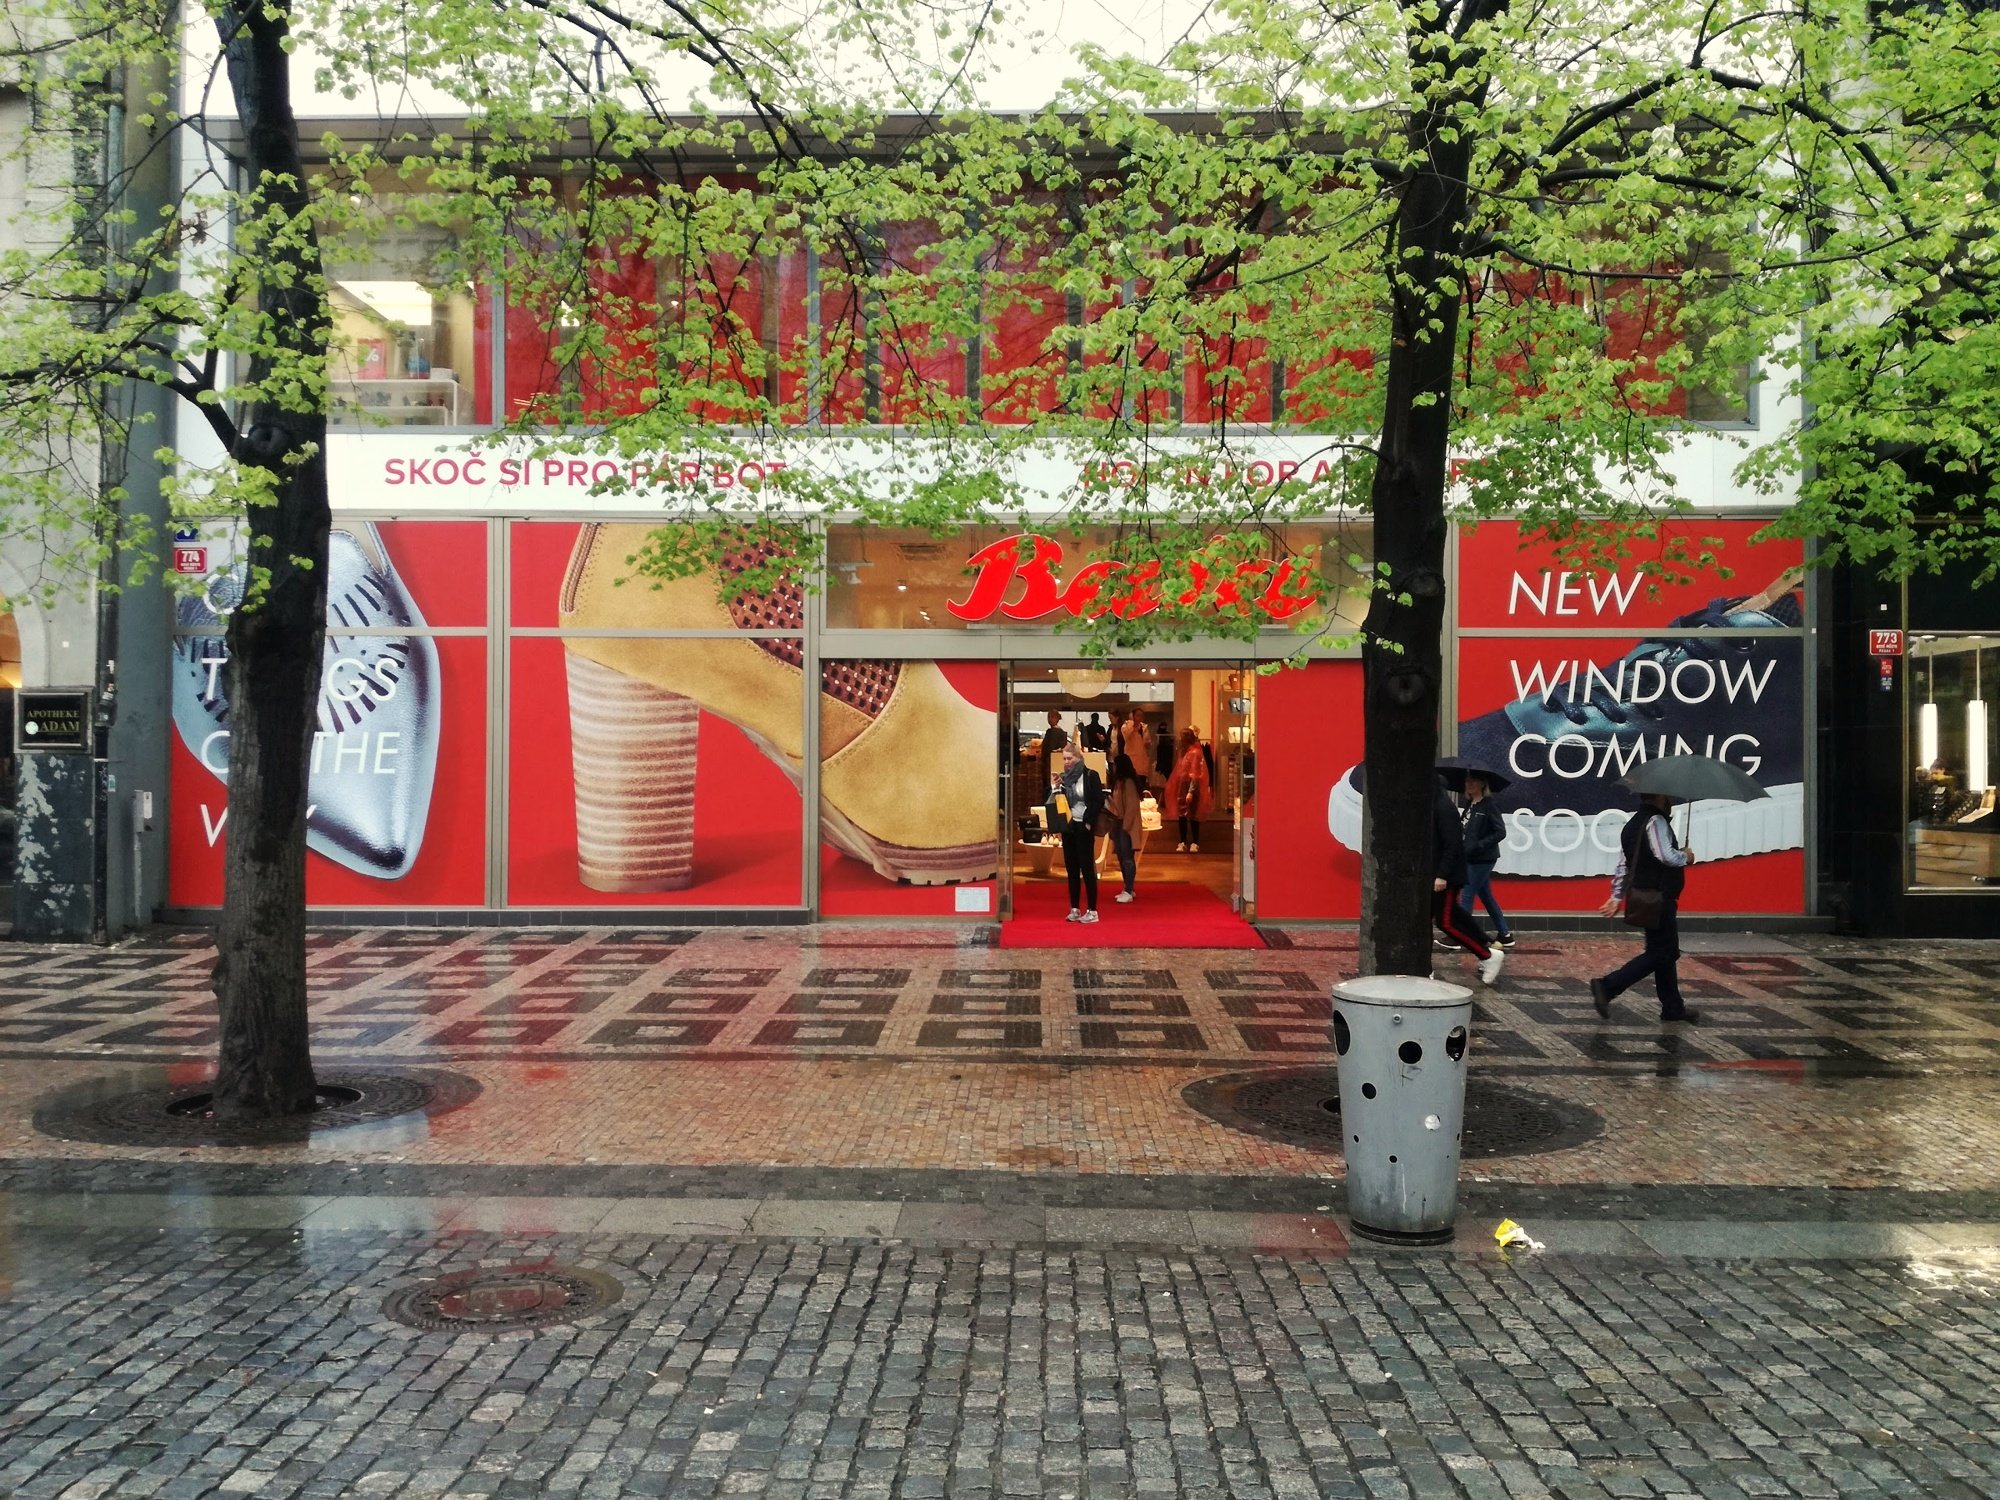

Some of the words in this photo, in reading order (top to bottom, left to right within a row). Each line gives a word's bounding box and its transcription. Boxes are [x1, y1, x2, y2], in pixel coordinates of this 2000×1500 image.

[384, 451, 486, 485] SKOČ
[499, 459, 530, 486] SI
[543, 459, 618, 487] PRO
[1508, 570, 1644, 616] NEW
[1876, 632, 1897, 643] 773
[201, 658, 401, 702] TGS
[1509, 659, 1777, 704] WINDOW
[27, 710, 80, 718] APOTHEKE
[41, 721, 80, 732] ADAM
[1507, 807, 1682, 853] SOO
